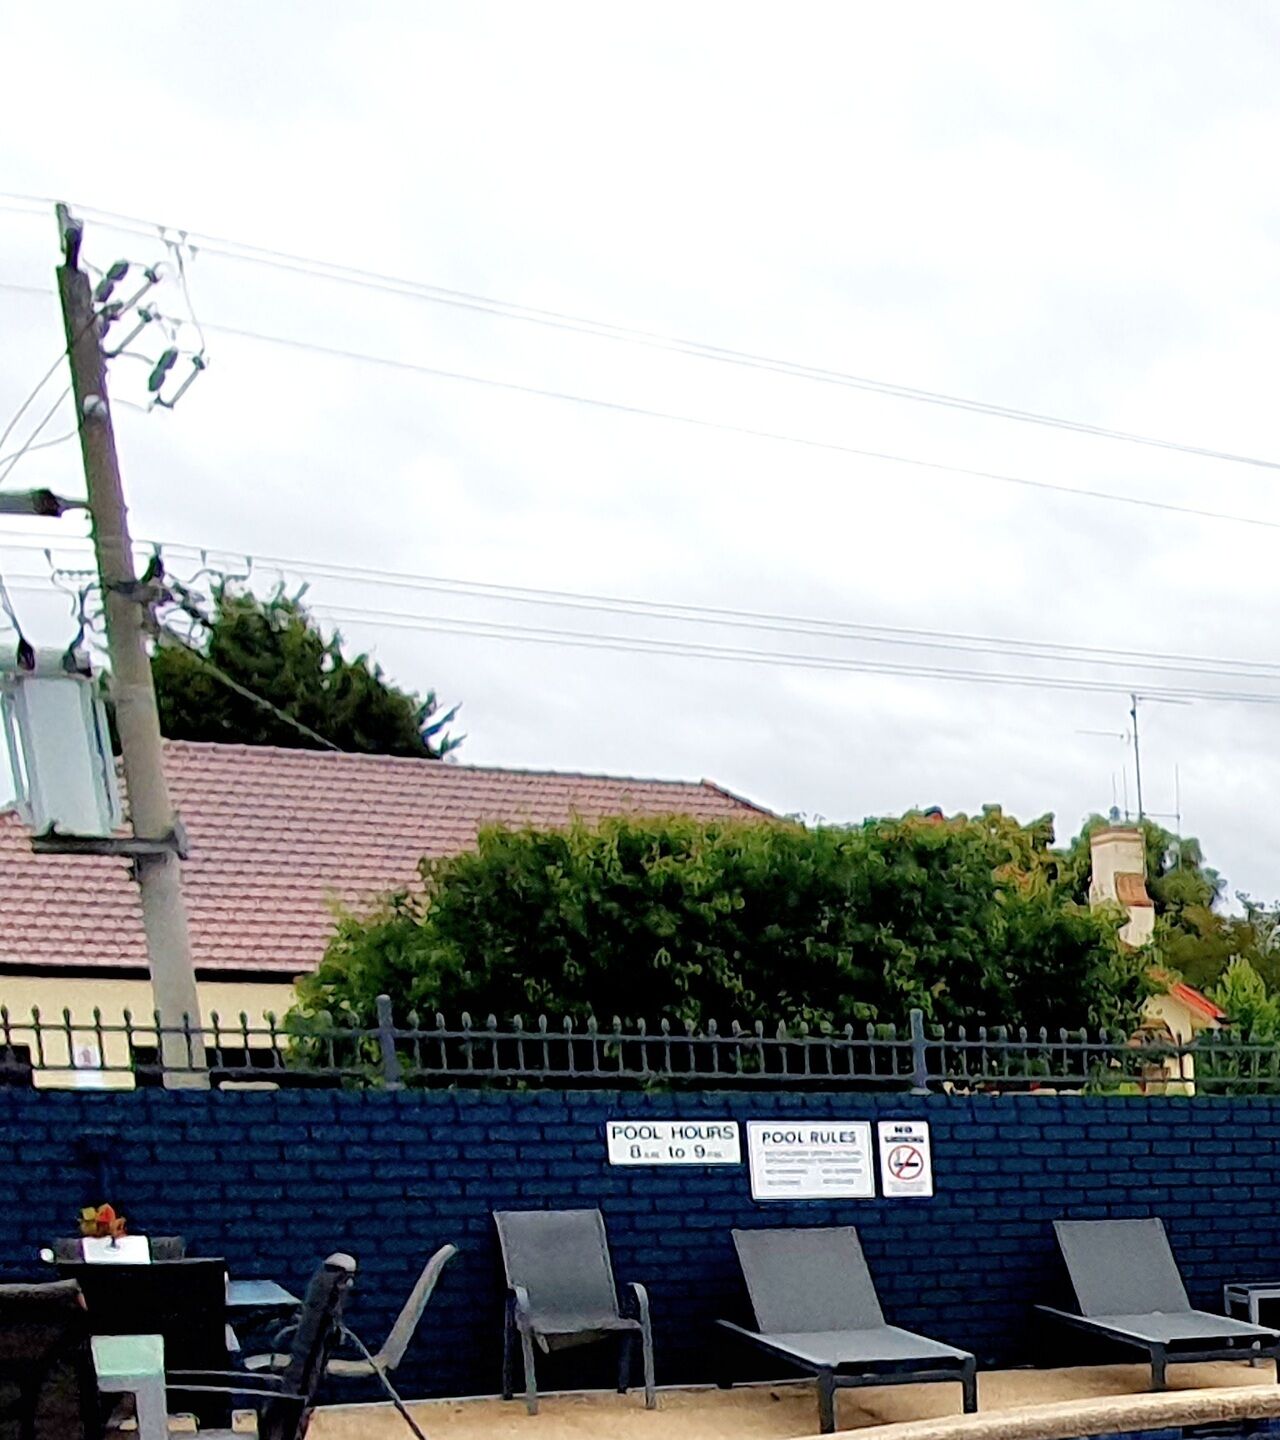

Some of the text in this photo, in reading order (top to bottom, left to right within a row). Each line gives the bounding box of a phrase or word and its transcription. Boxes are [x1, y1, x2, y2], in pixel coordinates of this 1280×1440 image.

[612, 1126, 734, 1140] POOL HOURS
[762, 1131, 856, 1144] POOL RULES
[668, 1146, 685, 1159] to
